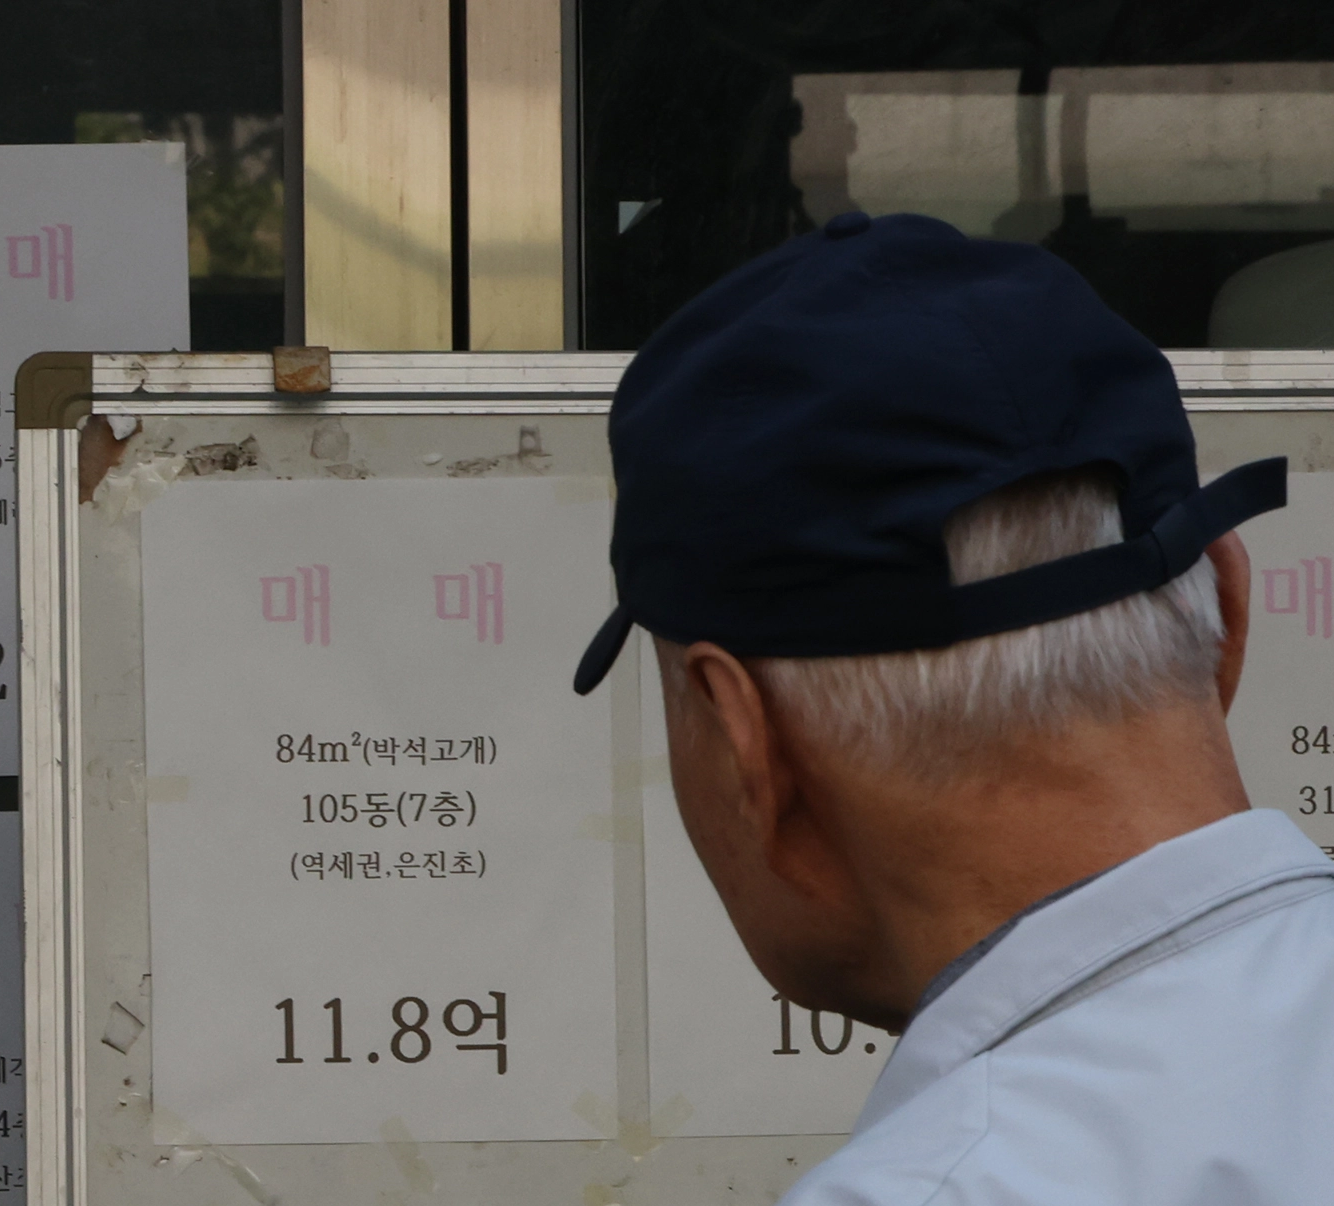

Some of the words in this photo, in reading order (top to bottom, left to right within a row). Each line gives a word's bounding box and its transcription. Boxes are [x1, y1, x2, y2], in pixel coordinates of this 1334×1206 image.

[5, 222, 76, 303] 매
[259, 563, 332, 647] 매
[432, 561, 505, 646] 매
[1261, 555, 1334, 640] 매
[302, 790, 477, 829] 105동(7층)
[274, 990, 508, 1076] 11.8억
[772, 993, 900, 1056] 10.
